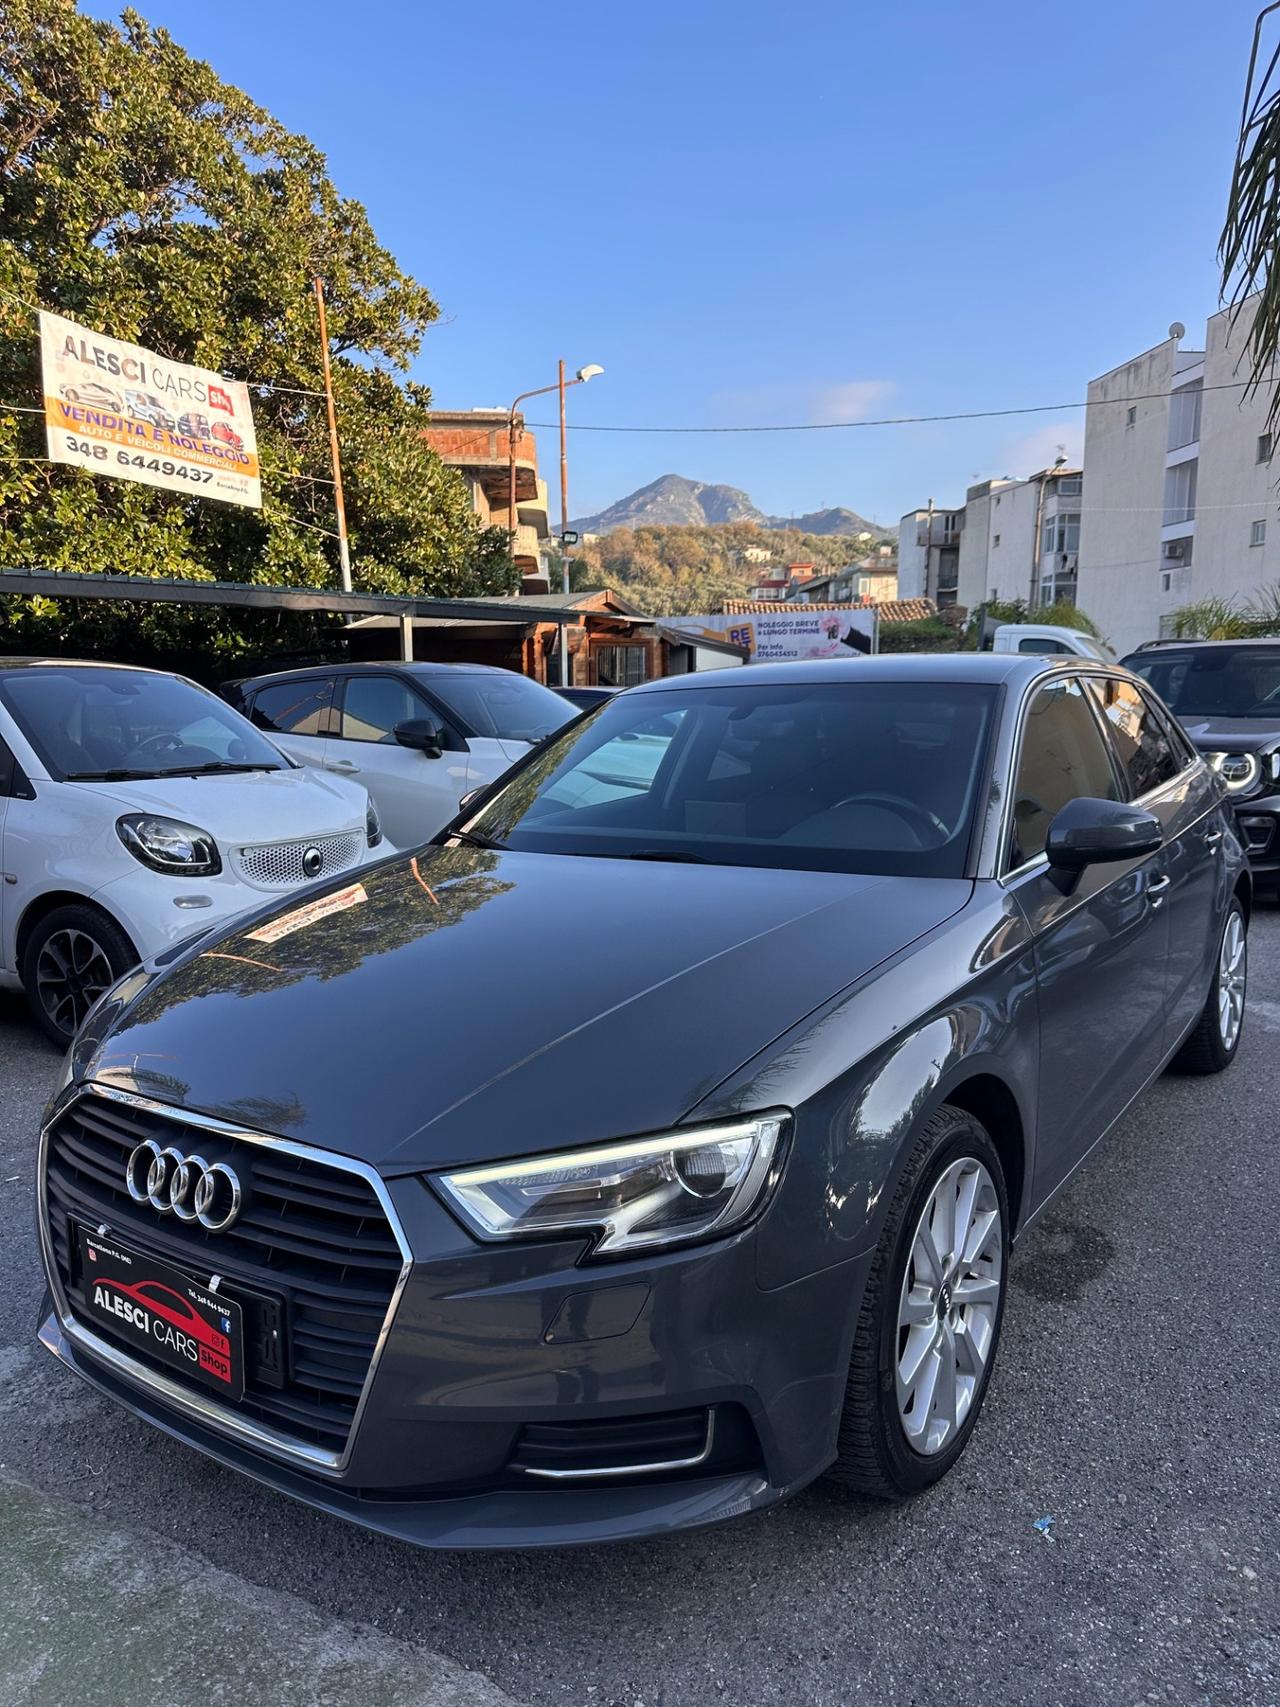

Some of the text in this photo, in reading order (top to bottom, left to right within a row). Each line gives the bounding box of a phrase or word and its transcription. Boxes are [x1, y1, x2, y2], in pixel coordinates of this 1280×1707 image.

[62, 335, 207, 402] ALESCI CARS
[60, 403, 250, 465] VENDITA E NOLEGGIO
[78, 424, 112, 440] AUTO
[115, 433, 123, 443] E
[127, 436, 171, 454] VEICOLI
[66, 435, 214, 485] 348 6449437
[730, 627, 750, 642] RE
[93, 1286, 199, 1363] ALESCI CARS
[201, 1350, 228, 1376] Shop
